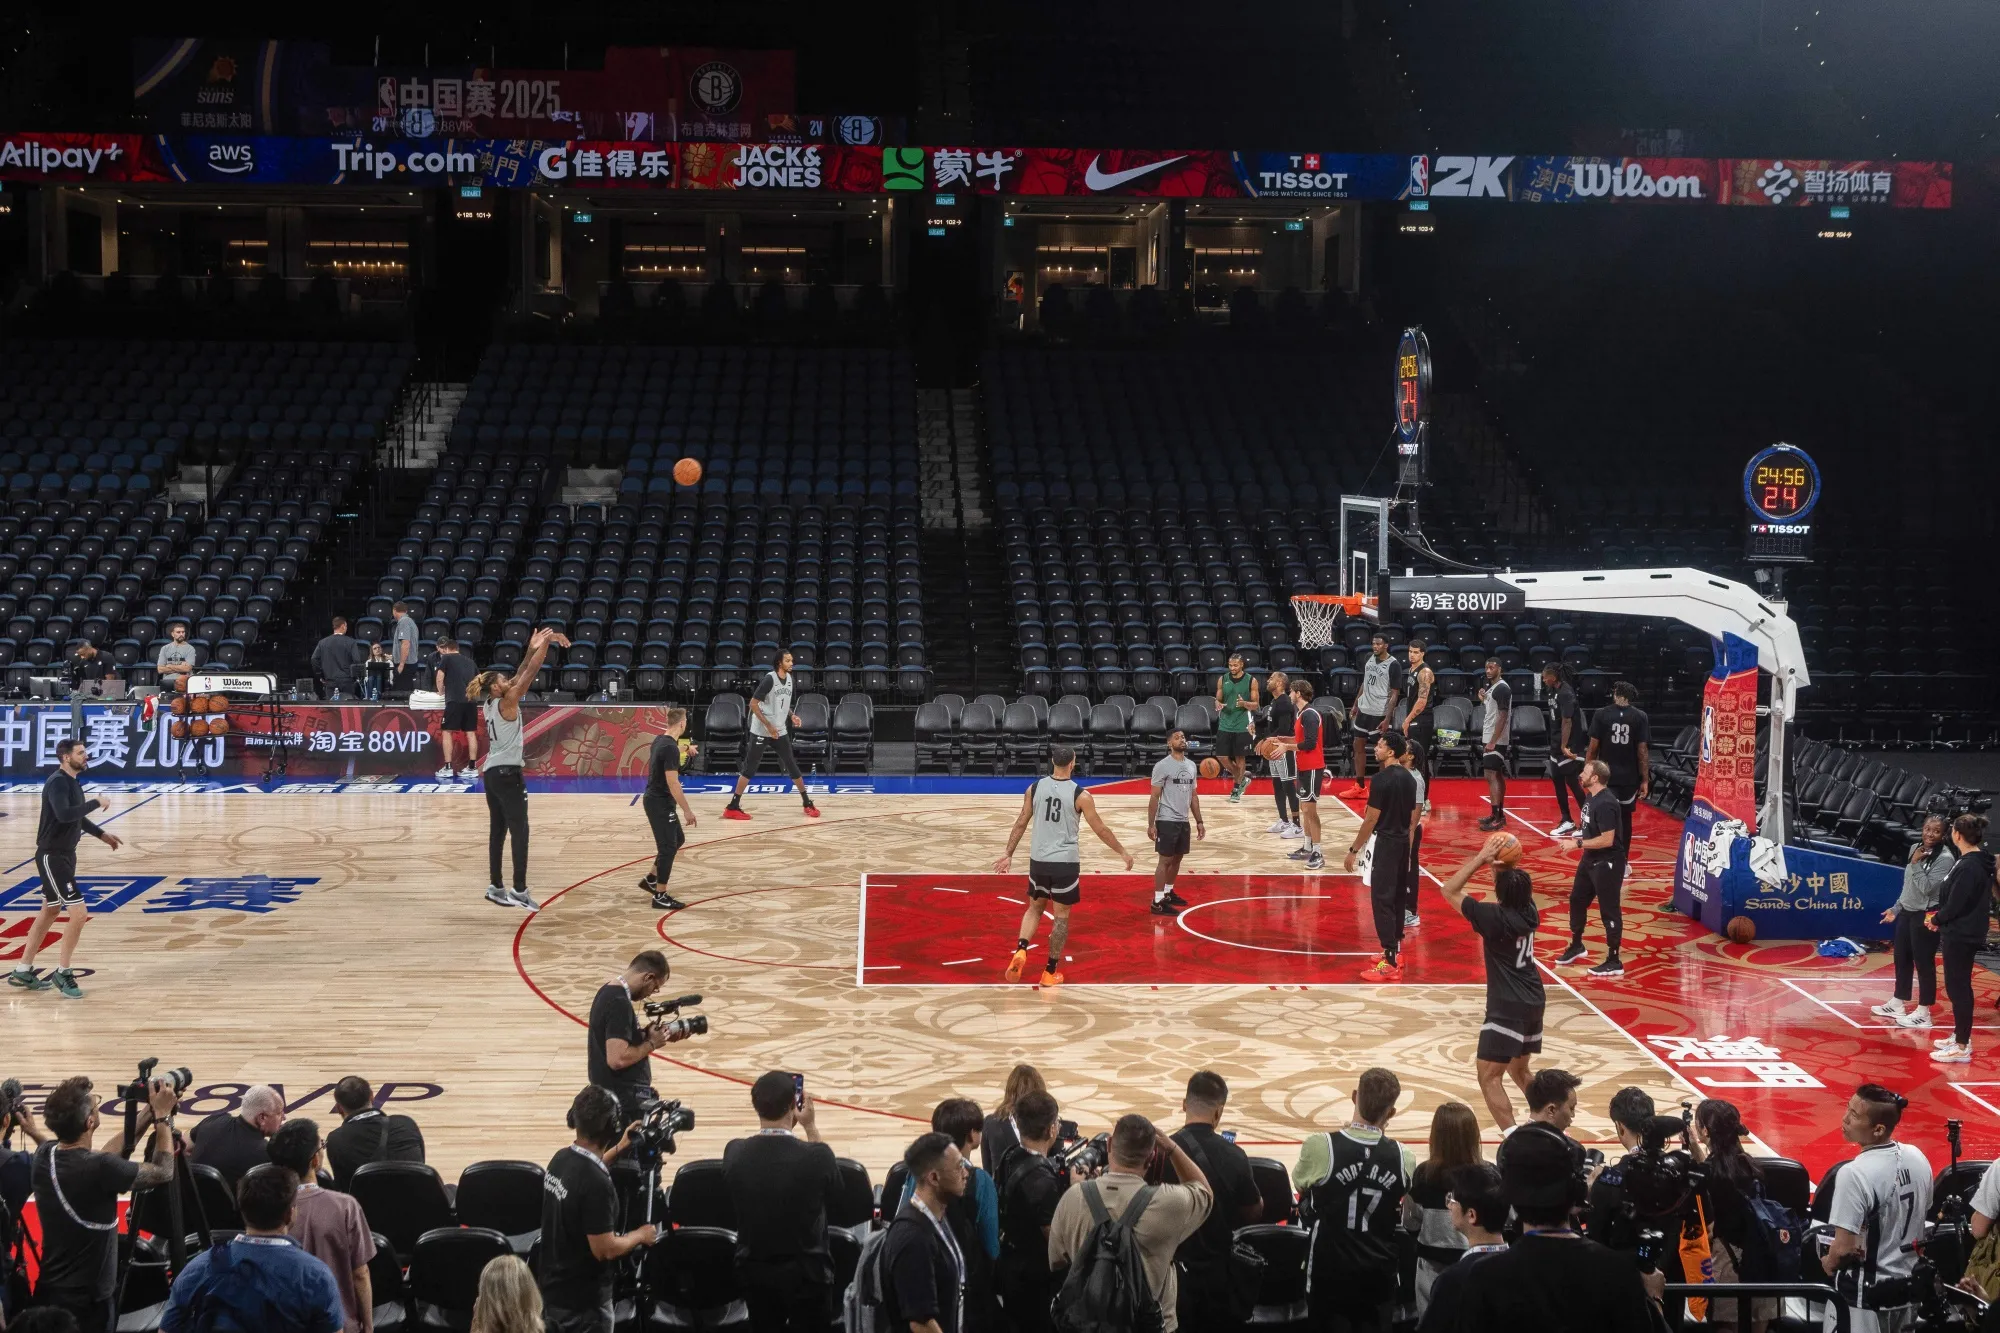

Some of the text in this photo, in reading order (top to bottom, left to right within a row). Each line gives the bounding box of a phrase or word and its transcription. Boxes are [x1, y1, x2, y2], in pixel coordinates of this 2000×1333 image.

[209, 144, 252, 160] aws
[331, 143, 476, 179] Trip.com
[572, 150, 670, 178] 佳得乐
[733, 146, 822, 167] JACK&
[733, 167, 822, 188] JONES
[933, 148, 1015, 191] 蒙牛
[1260, 172, 1348, 190] TISSOT
[1429, 156, 1516, 198] 2K
[1571, 163, 1702, 198] Wilson
[1804, 169, 1892, 194] 智扬体育
[1757, 467, 1805, 486] 24:56
[1764, 486, 1797, 510] 24
[1767, 525, 1811, 534] TISSOT
[1409, 592, 1508, 612] 淘宝88VIP
[222, 678, 253, 687] Wilson
[308, 730, 432, 753] 淘宝88VIP
[1611, 723, 1630, 745] 33
[1045, 796, 1062, 823] 13
[1744, 897, 1791, 910] Sands
[1794, 896, 1838, 910] China
[1515, 931, 1534, 969] 24
[1335, 1161, 1379, 1186] PORTR
[1347, 1187, 1383, 1232] 17
[1899, 1191, 1915, 1241] 7
